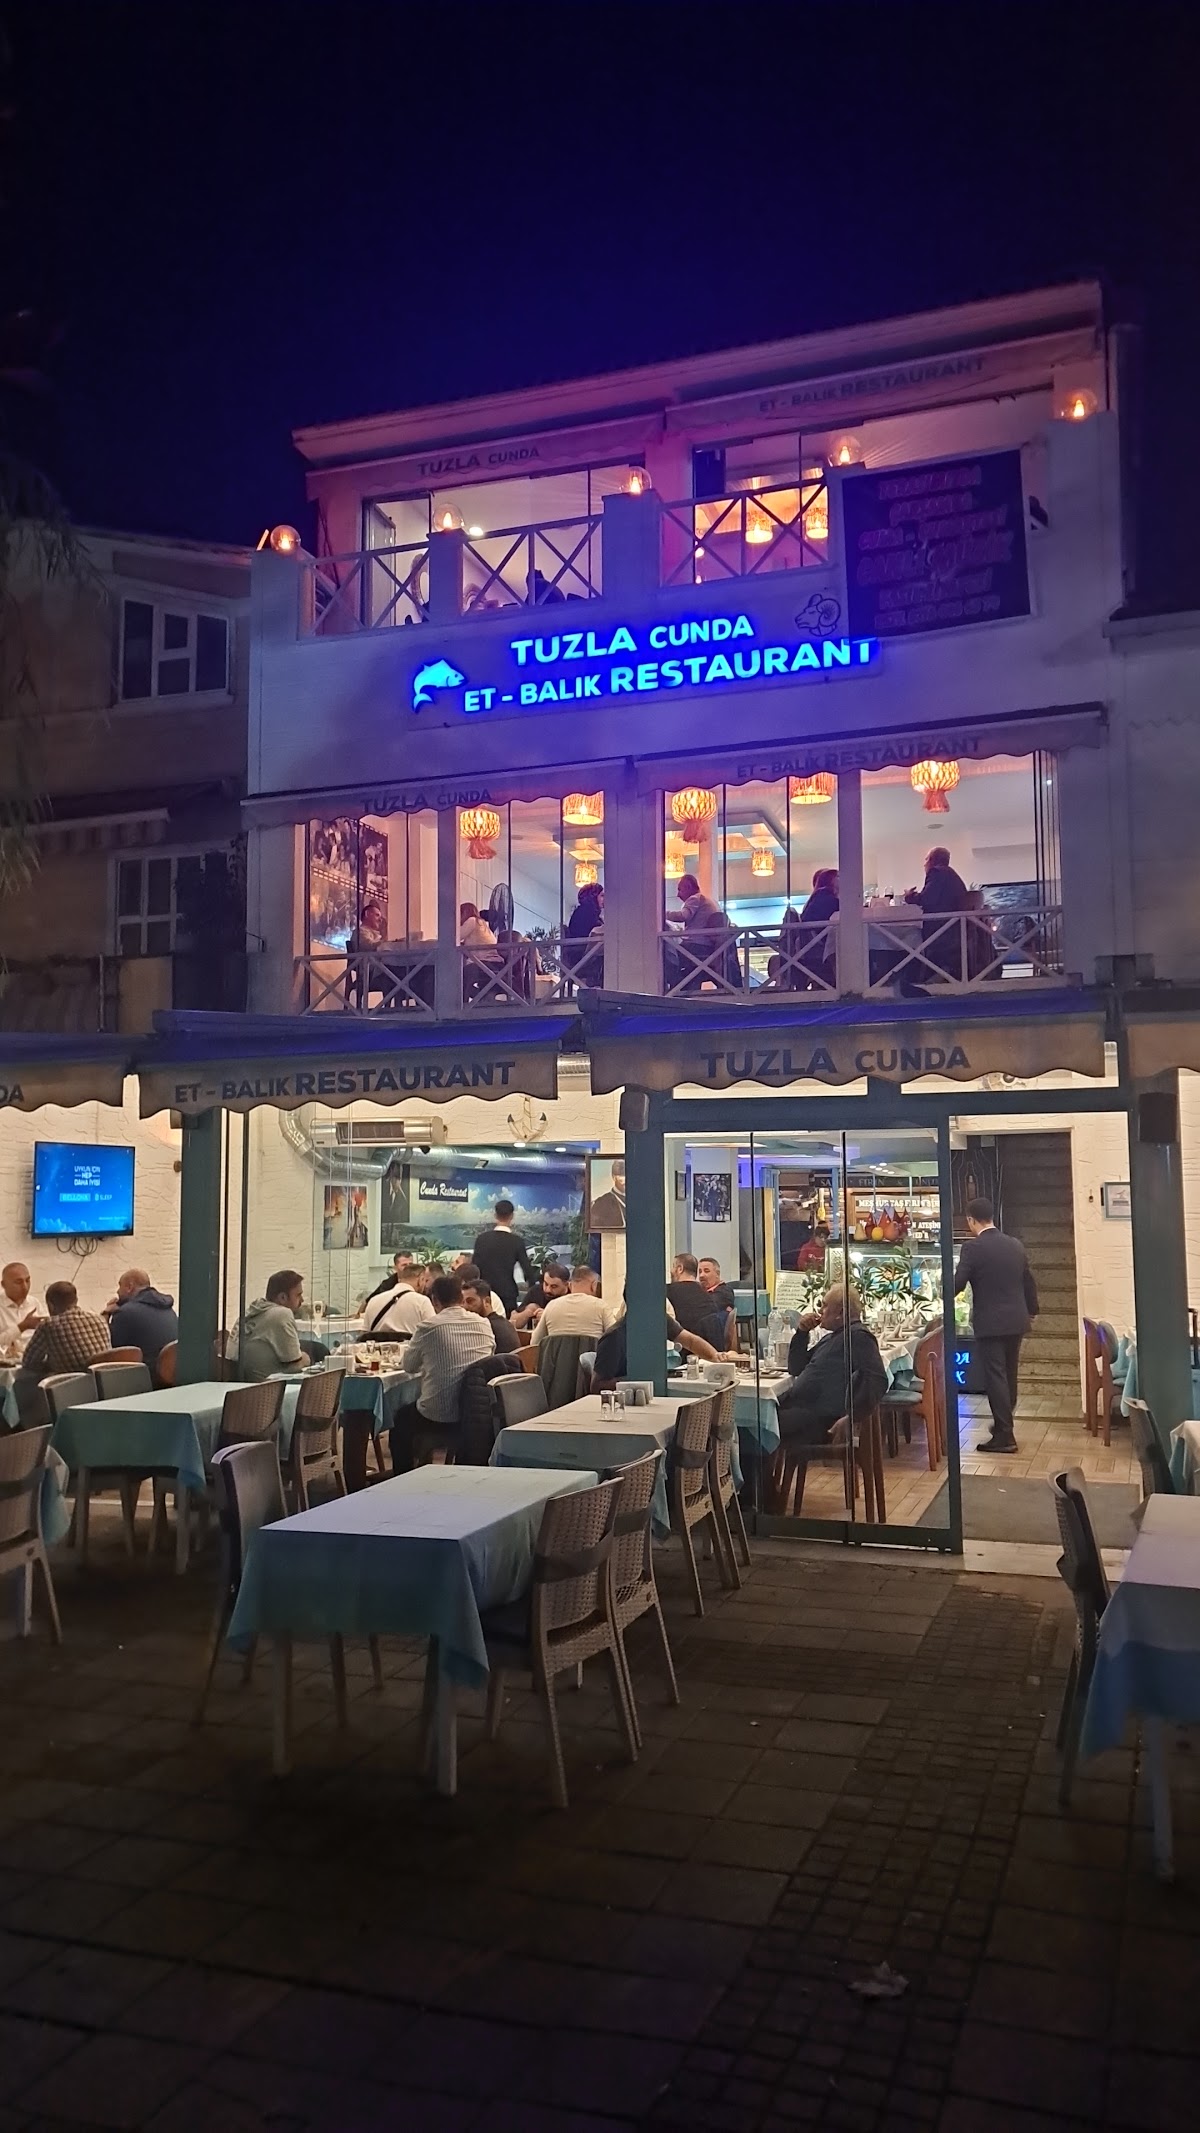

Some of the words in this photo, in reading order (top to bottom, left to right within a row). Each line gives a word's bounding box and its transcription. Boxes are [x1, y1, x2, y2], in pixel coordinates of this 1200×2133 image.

[759, 399, 777, 412] ET
[792, 390, 837, 406] BALIK
[840, 357, 986, 397] RESTAURANT
[417, 454, 480, 476] TUZLA
[488, 448, 540, 465] CUNDA
[511, 626, 637, 666] TUZLA
[649, 615, 754, 649] CUNDA
[465, 688, 496, 712] ET
[520, 674, 602, 705] BALIK
[610, 637, 877, 693] RESTAURANT
[737, 763, 756, 778] ET
[771, 756, 821, 774] BALIK
[824, 736, 981, 770] RESTAURANT
[360, 792, 428, 813] TUZLA
[437, 789, 492, 805] CUNDA
[175, 1083, 201, 1103] ET
[222, 1077, 290, 1100] BALIK
[295, 1062, 516, 1095] RESTAURANT
[700, 1048, 838, 1078] TUZLA
[855, 1046, 971, 1072] CUNDA
